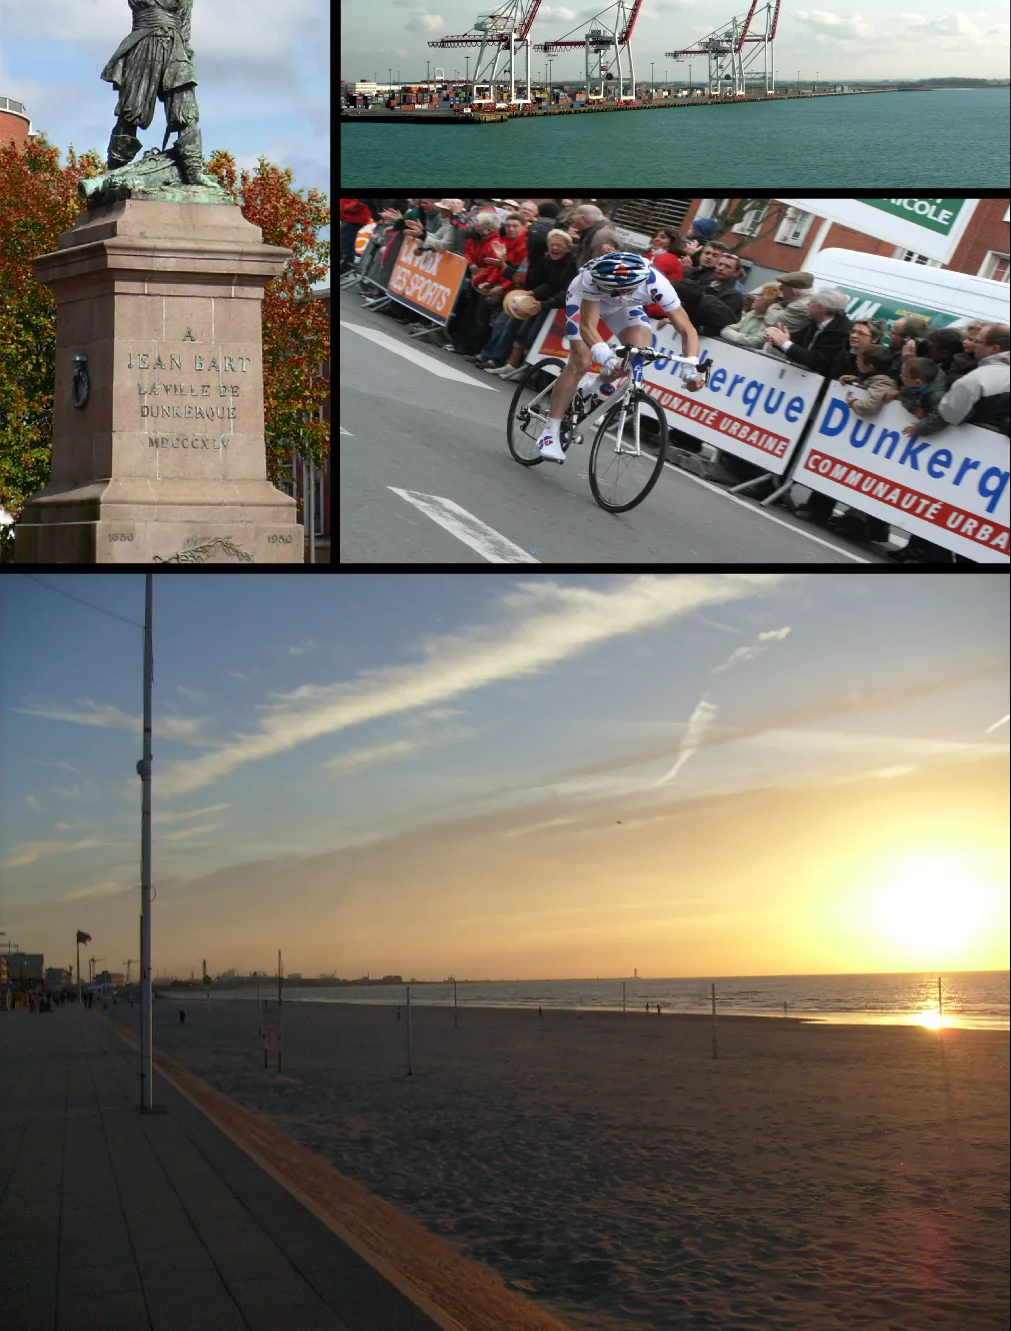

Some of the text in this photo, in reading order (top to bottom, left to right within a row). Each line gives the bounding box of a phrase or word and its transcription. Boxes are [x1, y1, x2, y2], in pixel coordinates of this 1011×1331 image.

[388, 264, 452, 312] DES SPORTS
[182, 326, 196, 342] A
[127, 352, 251, 373] JEAN BART
[137, 383, 241, 398] LA VILLE DE
[140, 405, 237, 421] DUNKERQUE
[148, 436, 231, 450] MDCCCXLV
[719, 414, 788, 457] URBAINE
[818, 397, 1010, 514] Dunkerq
[807, 453, 944, 520] COMMUNAUTÉ
